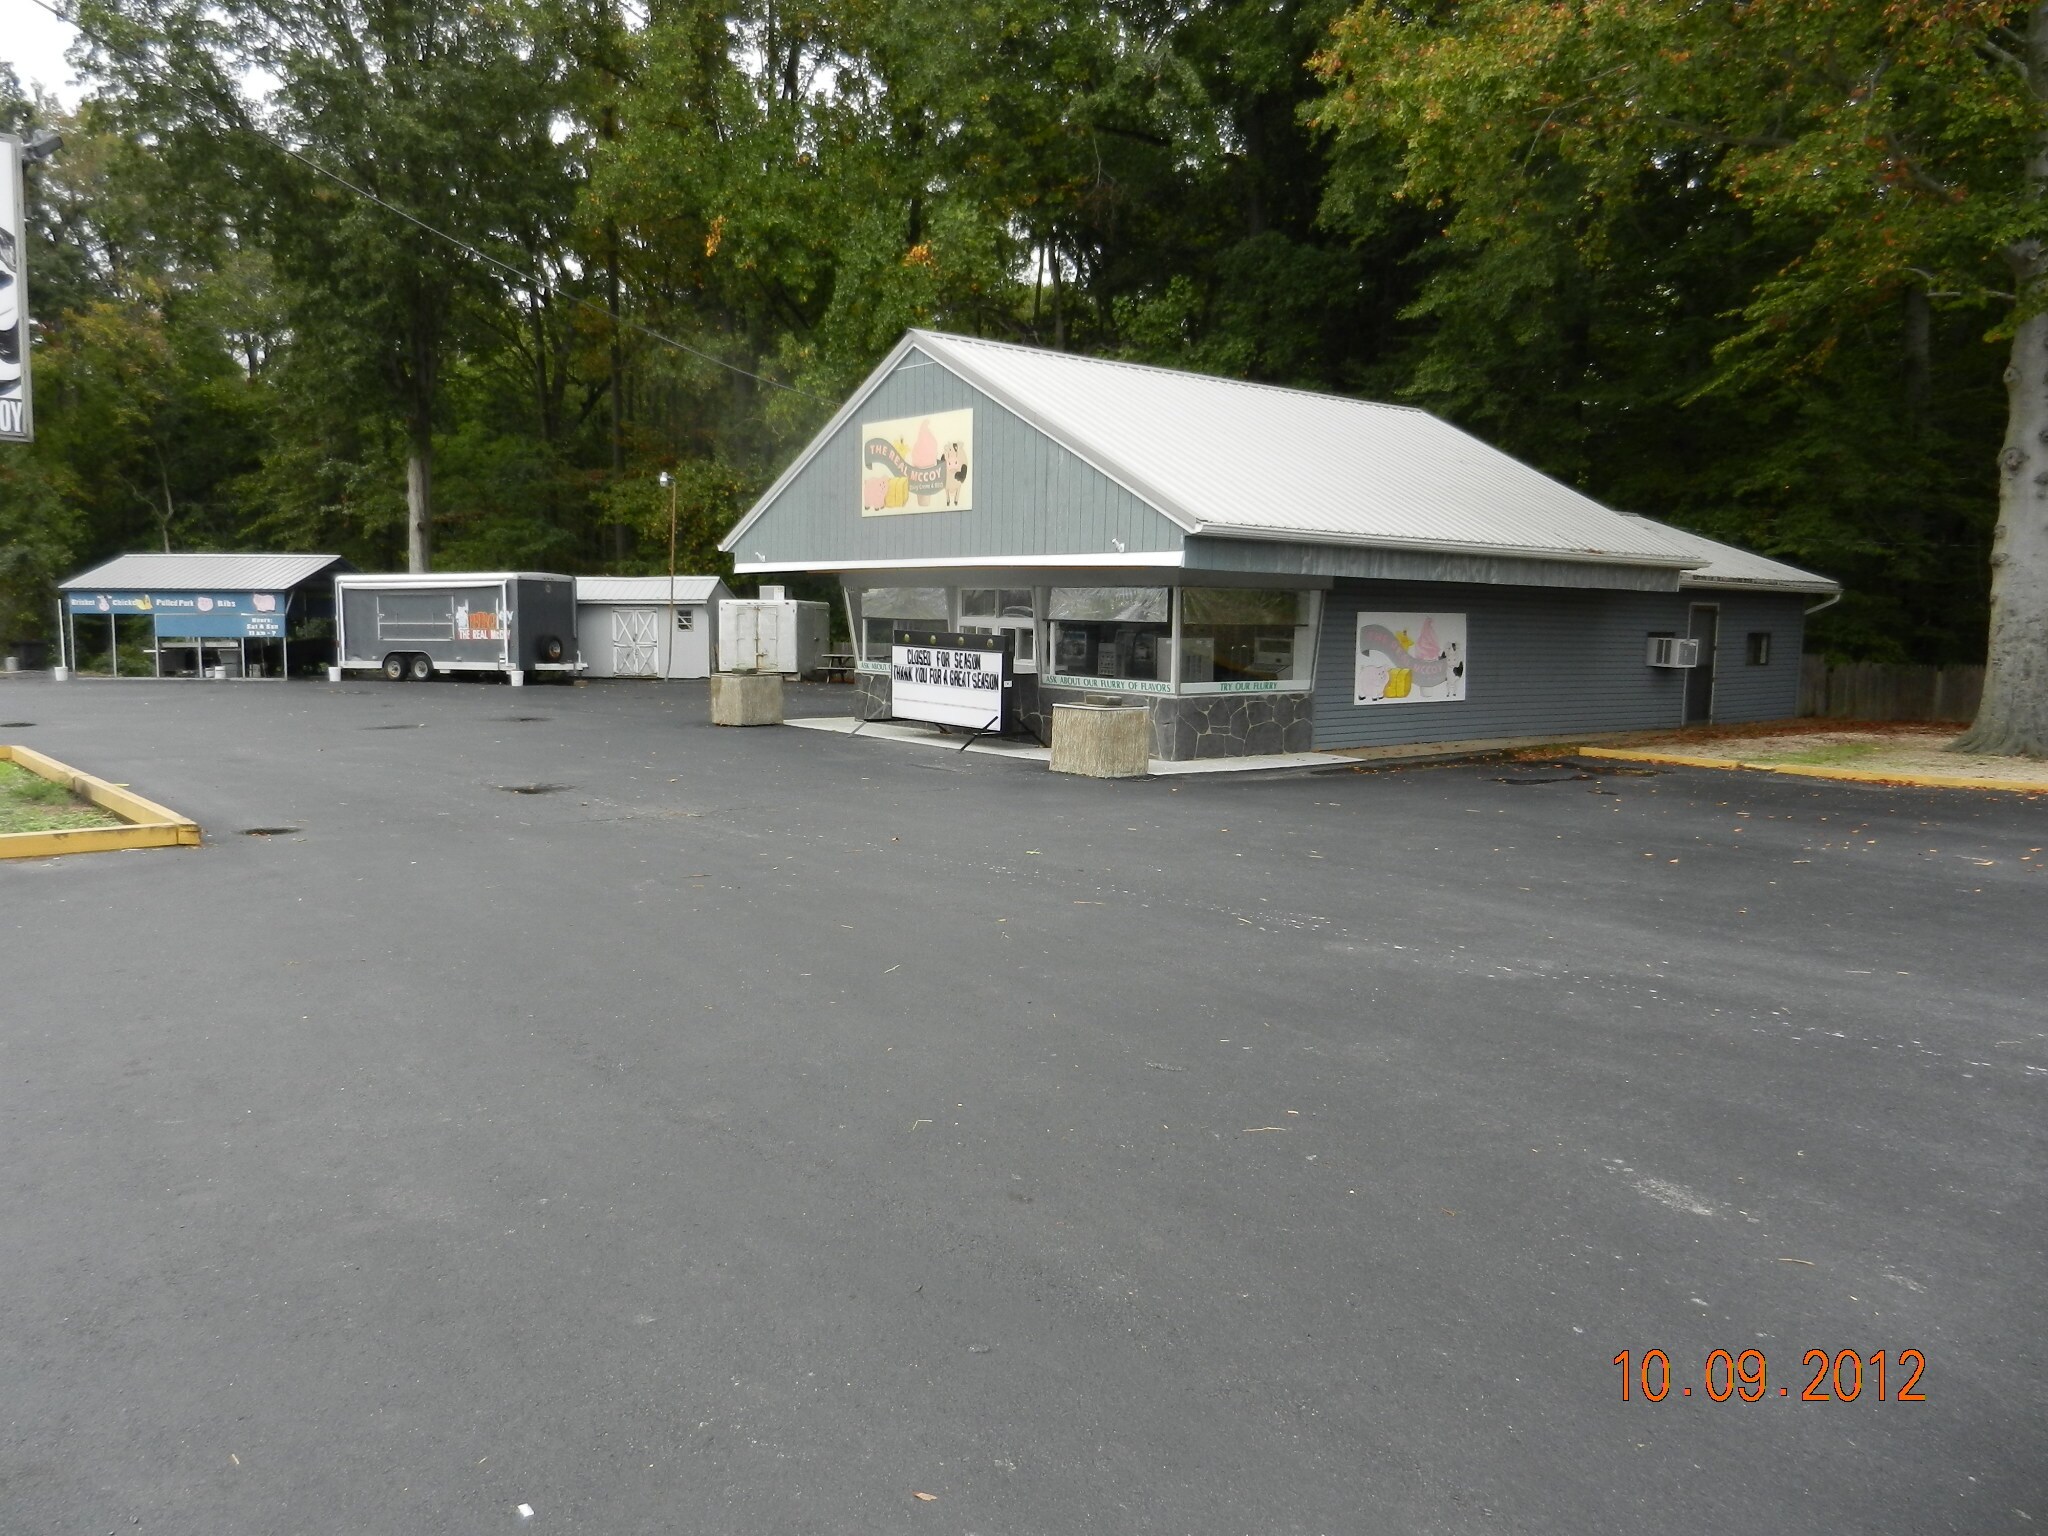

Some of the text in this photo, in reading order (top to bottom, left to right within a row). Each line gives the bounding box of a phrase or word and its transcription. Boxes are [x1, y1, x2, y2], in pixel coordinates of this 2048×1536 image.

[870, 444, 942, 482] THE REAL MCCOY
[459, 629, 470, 640] THE
[472, 629, 489, 640] REAL
[871, 663, 887, 671] ABOUT
[906, 649, 981, 671] CLOSED FOR SEASON
[893, 664, 999, 690] THANK YOU FOR A GREAT SEASON
[1046, 675, 1171, 693] ASK ABOUT OUR FLURRY OF FLAVORS
[1220, 681, 1278, 692] TRY OUR FLURRY
